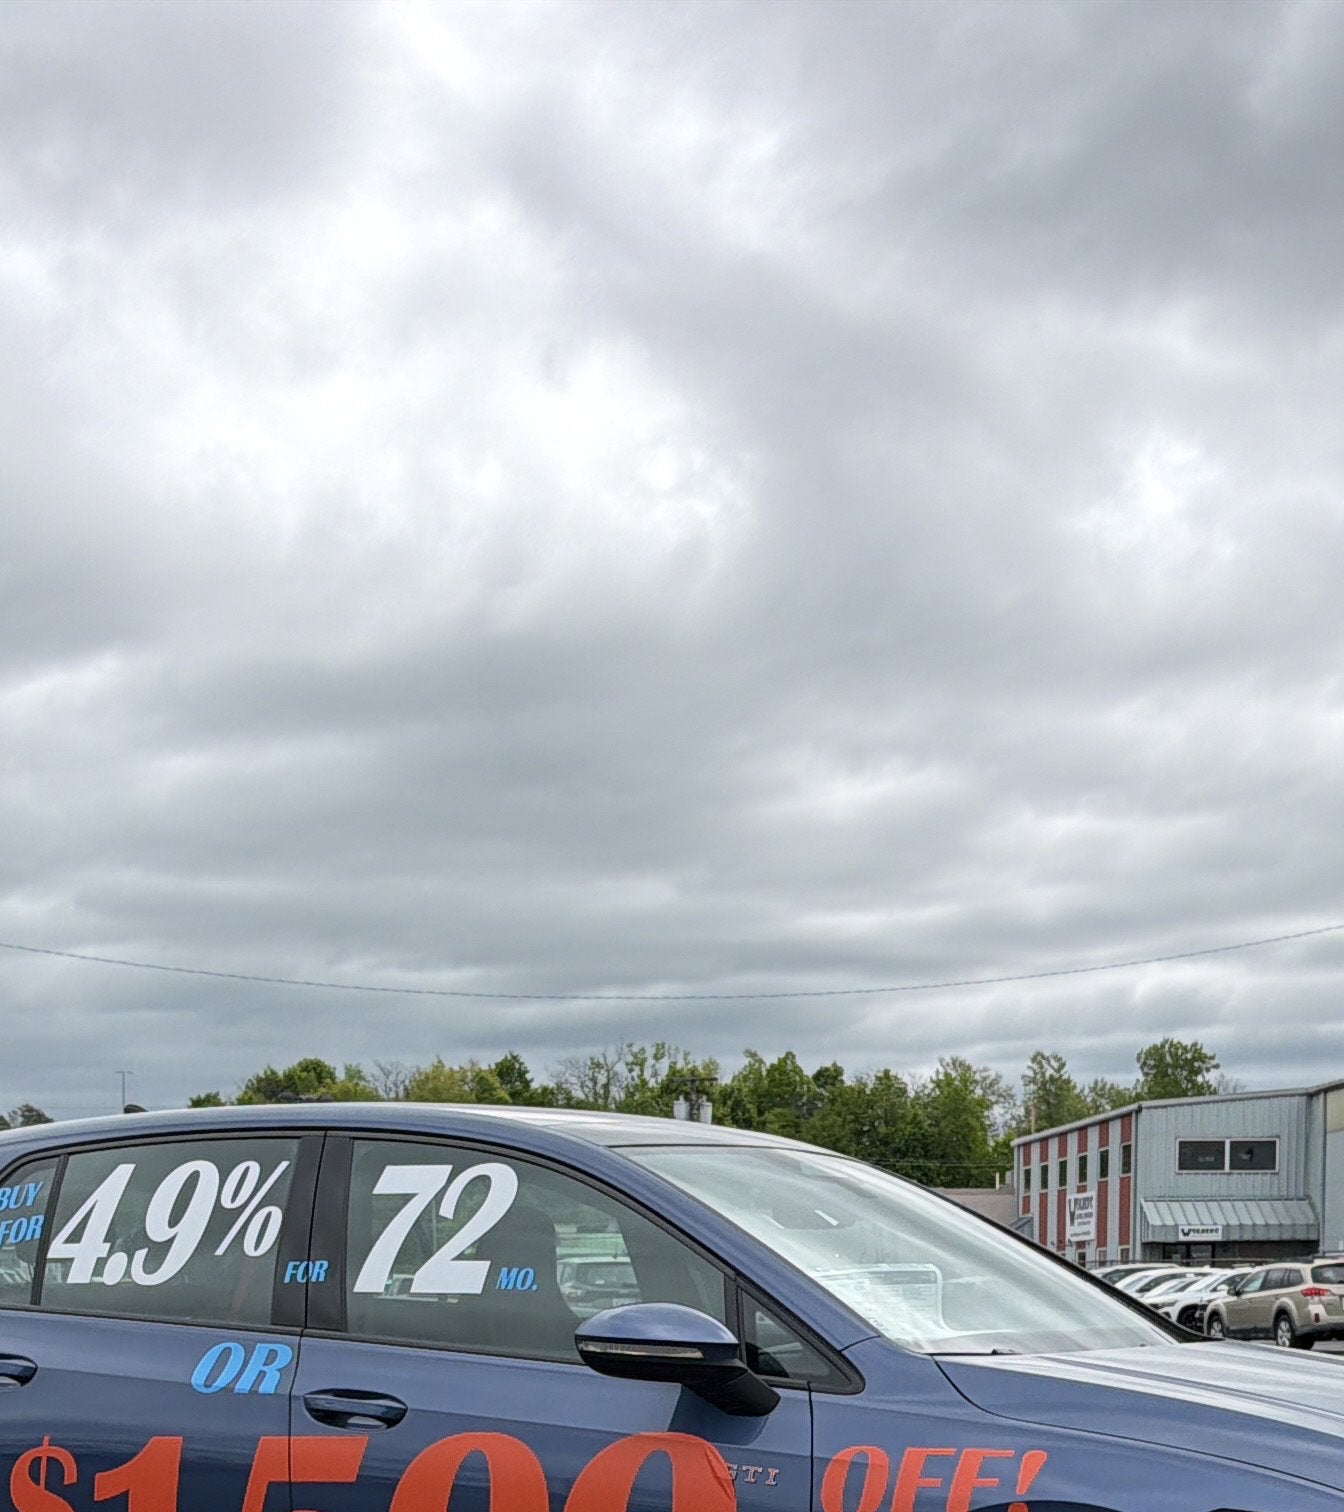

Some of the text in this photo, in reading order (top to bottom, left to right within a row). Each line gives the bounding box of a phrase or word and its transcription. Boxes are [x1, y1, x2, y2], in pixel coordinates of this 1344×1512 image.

[47, 1160, 539, 1294] 4.9% FOR 72 MO.
[190, 1342, 294, 1394] OR
